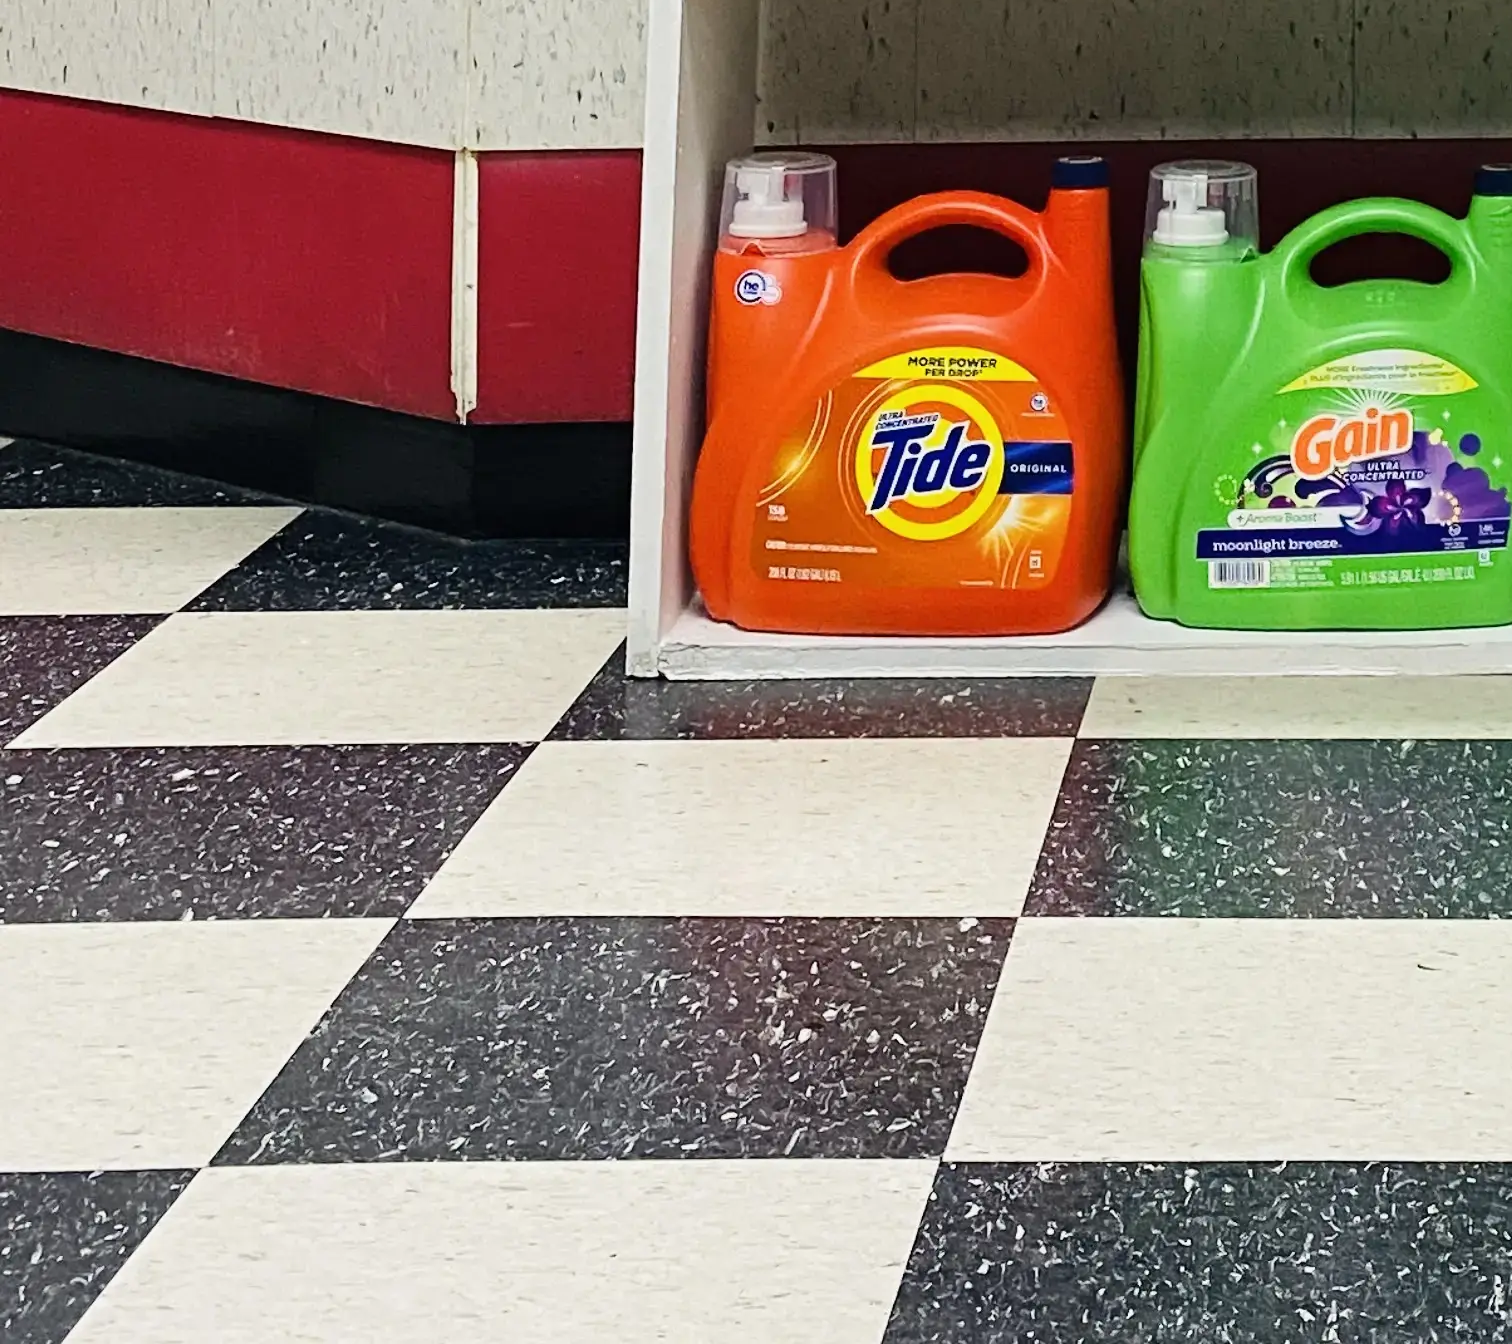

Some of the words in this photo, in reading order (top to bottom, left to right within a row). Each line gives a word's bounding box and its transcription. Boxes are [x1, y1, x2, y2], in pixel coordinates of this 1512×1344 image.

[907, 356, 945, 368] MORE
[948, 357, 998, 369] POWER
[925, 368, 945, 377] PER
[1294, 407, 1410, 477] Gain
[869, 423, 992, 511] Tide
[1009, 463, 1068, 474] ORIGINAL
[1367, 461, 1400, 471] ULTRA
[1343, 470, 1424, 483] CONCENTRATED
[1212, 538, 1286, 554] moonlight
